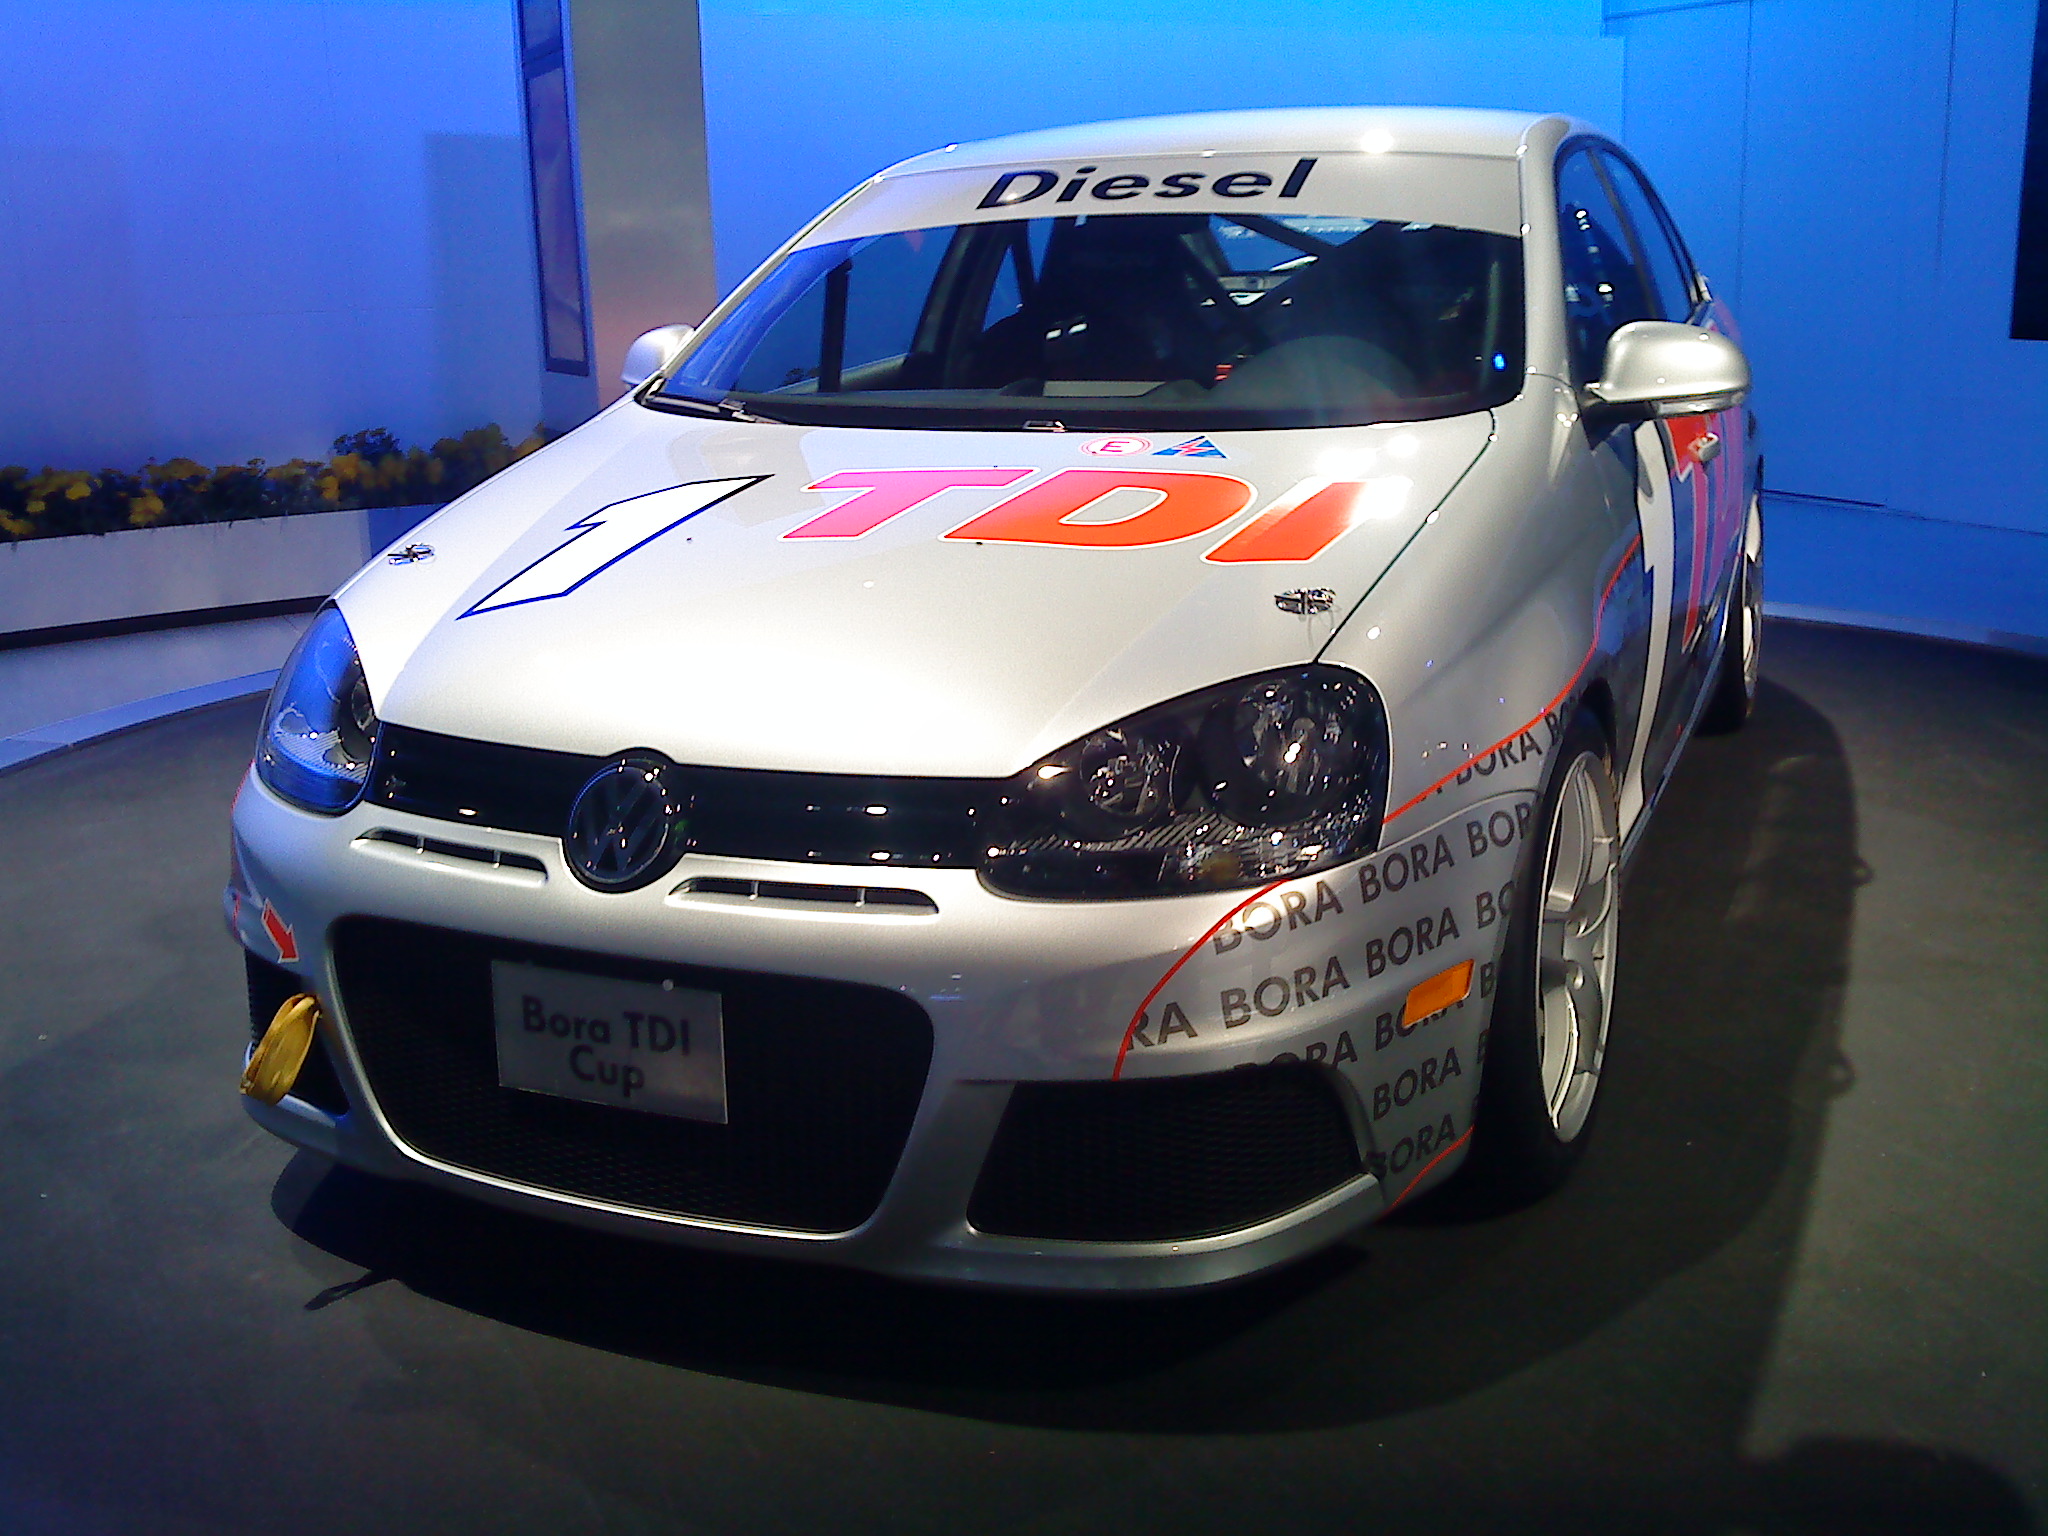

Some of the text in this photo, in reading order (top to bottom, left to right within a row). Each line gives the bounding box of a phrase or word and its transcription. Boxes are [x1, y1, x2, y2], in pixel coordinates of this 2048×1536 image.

[976, 158, 1318, 210] Diesel
[781, 468, 1366, 564] TDI
[1213, 880, 1344, 955] BORA
[1358, 834, 1455, 904] BORA
[1221, 956, 1351, 1029] BORA
[1366, 907, 1460, 978] BORA
[521, 994, 690, 1057] Bora TDI
[569, 1044, 646, 1098] Cup
[1373, 1046, 1462, 1121] BORA
